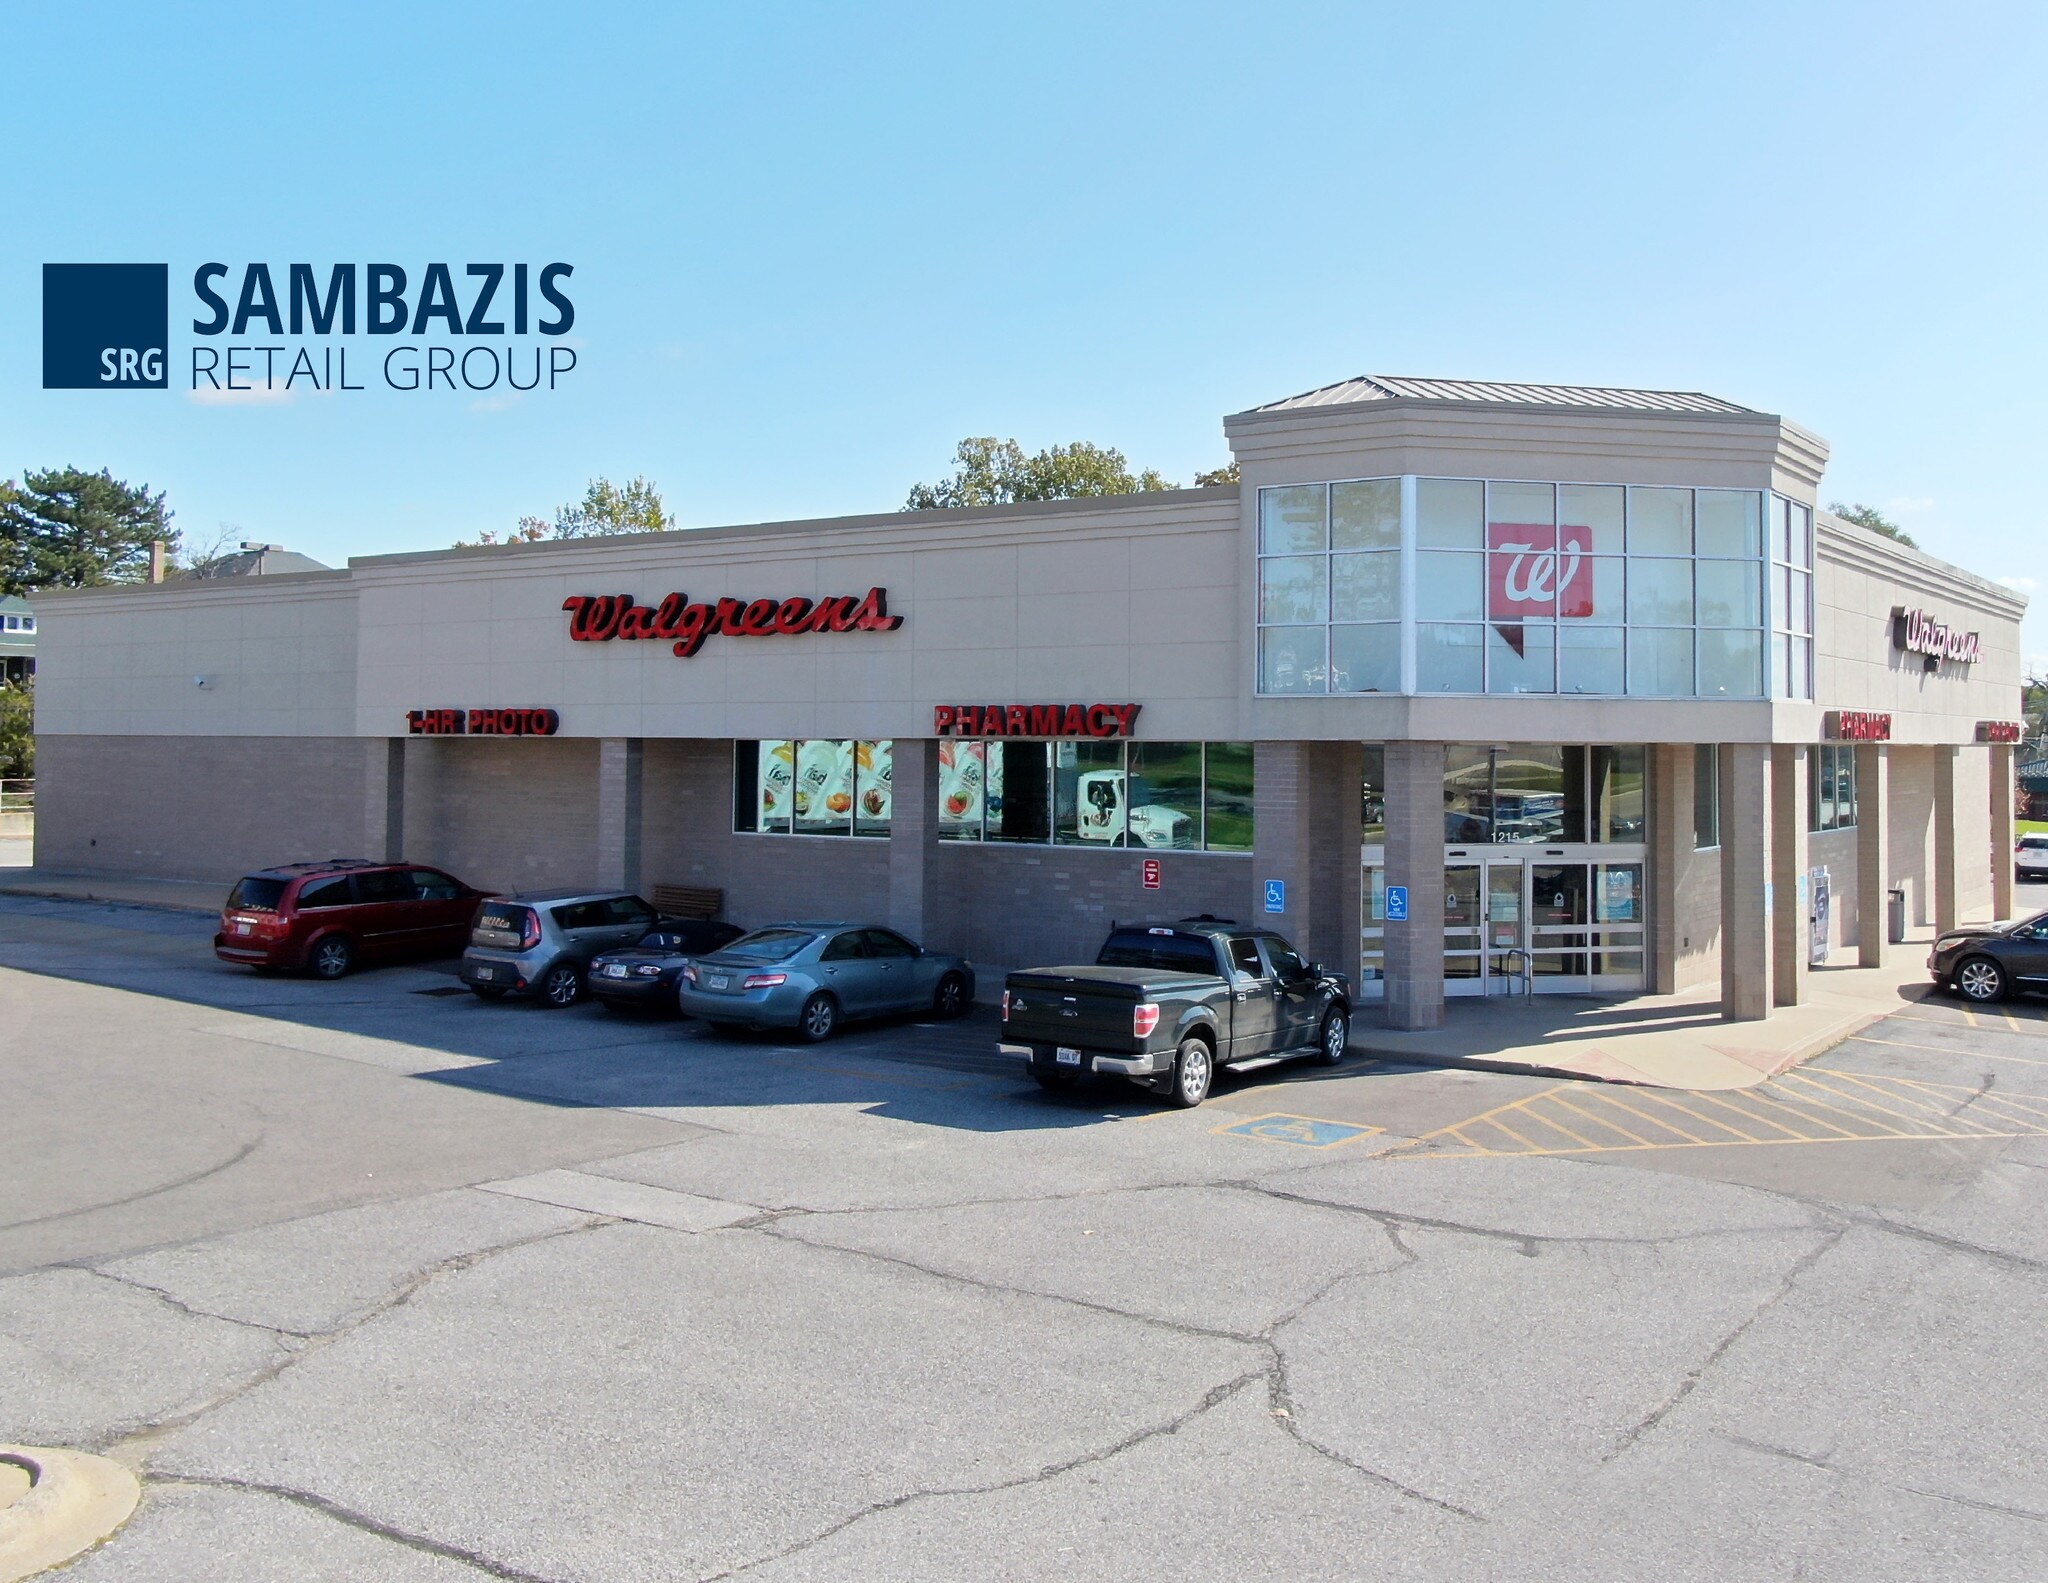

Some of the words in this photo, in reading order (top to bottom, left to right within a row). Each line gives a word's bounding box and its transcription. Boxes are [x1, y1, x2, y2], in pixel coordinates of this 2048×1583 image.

[562, 586, 904, 657] Walgreens
[406, 709, 459, 734] 1-HR
[469, 708, 553, 735] PHOTO
[934, 703, 1140, 737] PHARMACY
[1491, 831, 1520, 844] 1215
